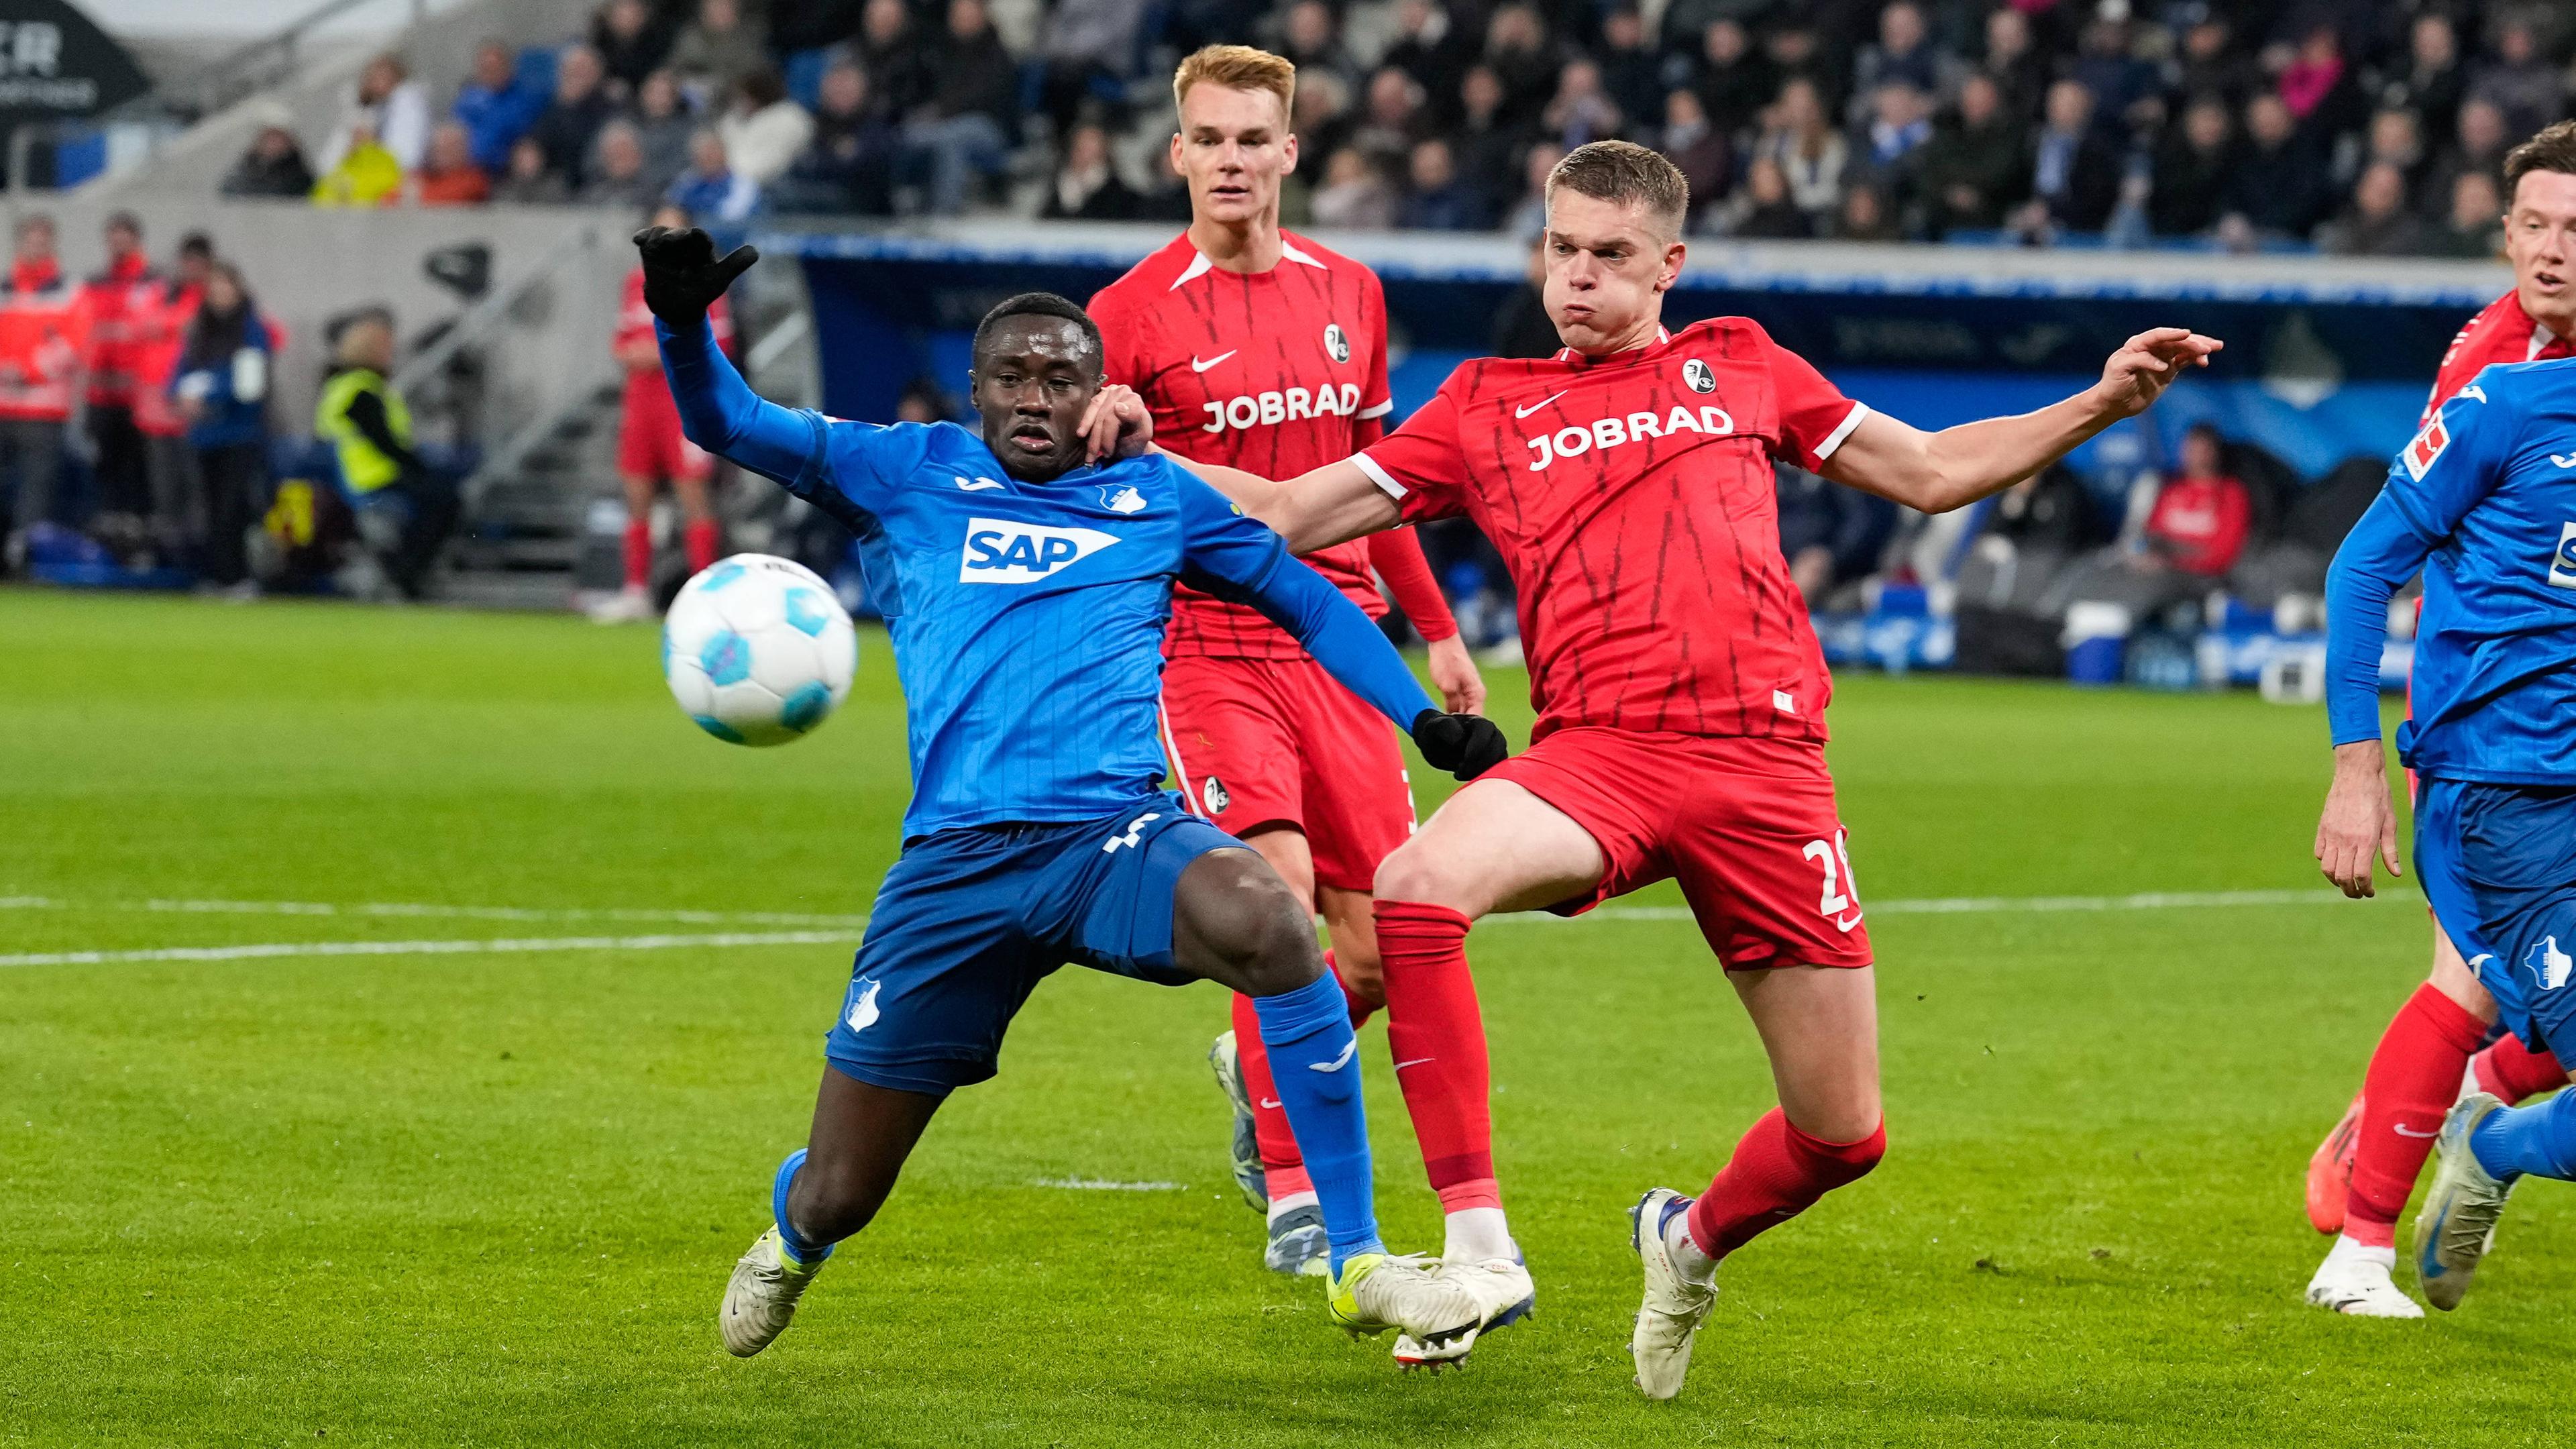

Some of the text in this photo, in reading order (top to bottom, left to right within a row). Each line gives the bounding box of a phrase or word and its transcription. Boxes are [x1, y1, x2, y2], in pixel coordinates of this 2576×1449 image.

[1202, 383, 1360, 433] JOBRAD
[1527, 405, 1734, 472] JOBRAD
[966, 531, 1077, 572] SAP
